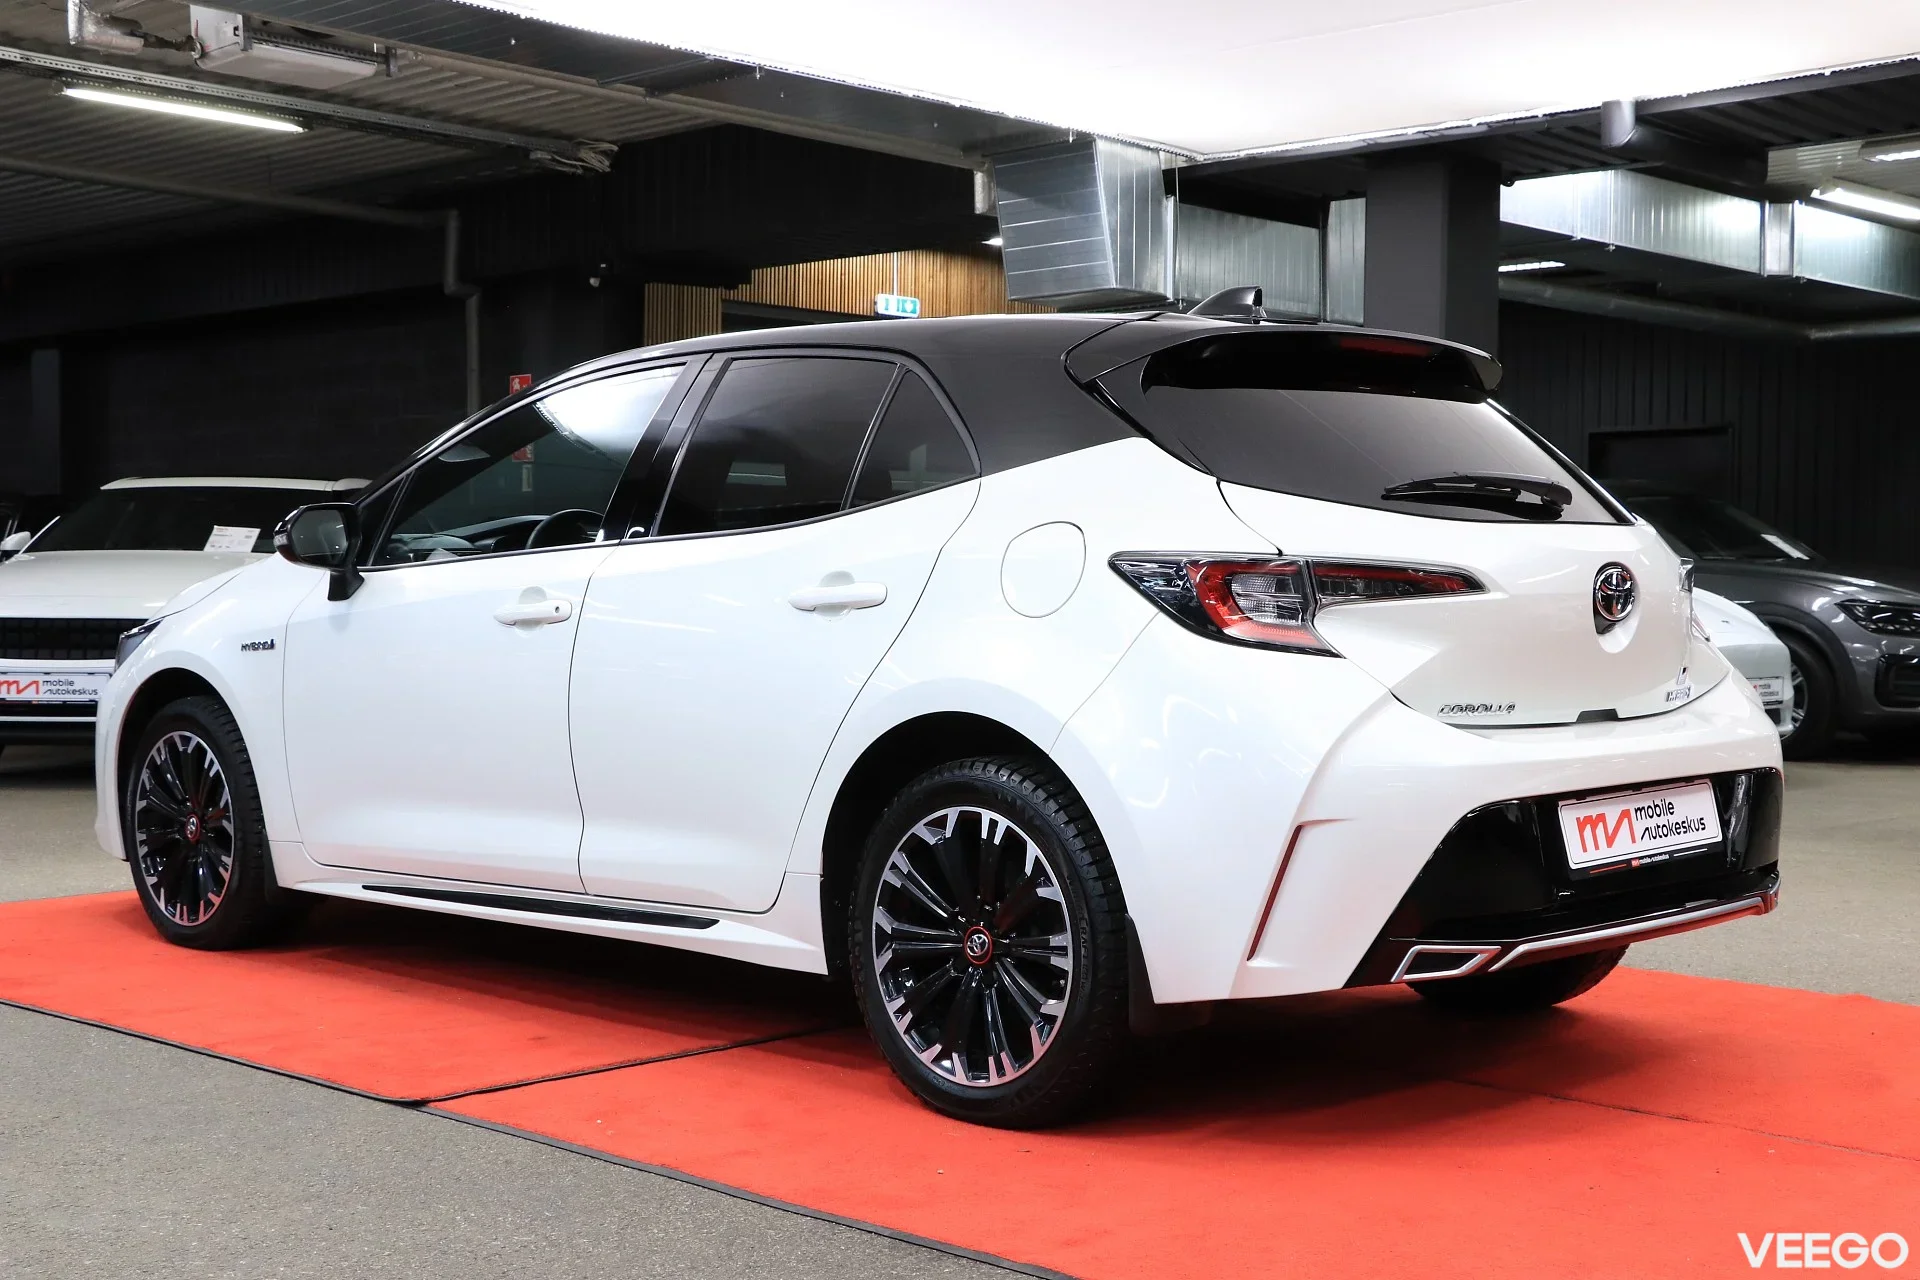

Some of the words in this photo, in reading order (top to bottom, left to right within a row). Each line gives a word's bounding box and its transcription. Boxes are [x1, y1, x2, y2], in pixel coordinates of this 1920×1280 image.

[42, 679, 75, 687] mobile
[1438, 702, 1516, 716] COROLLA
[1634, 798, 1675, 821] mobile
